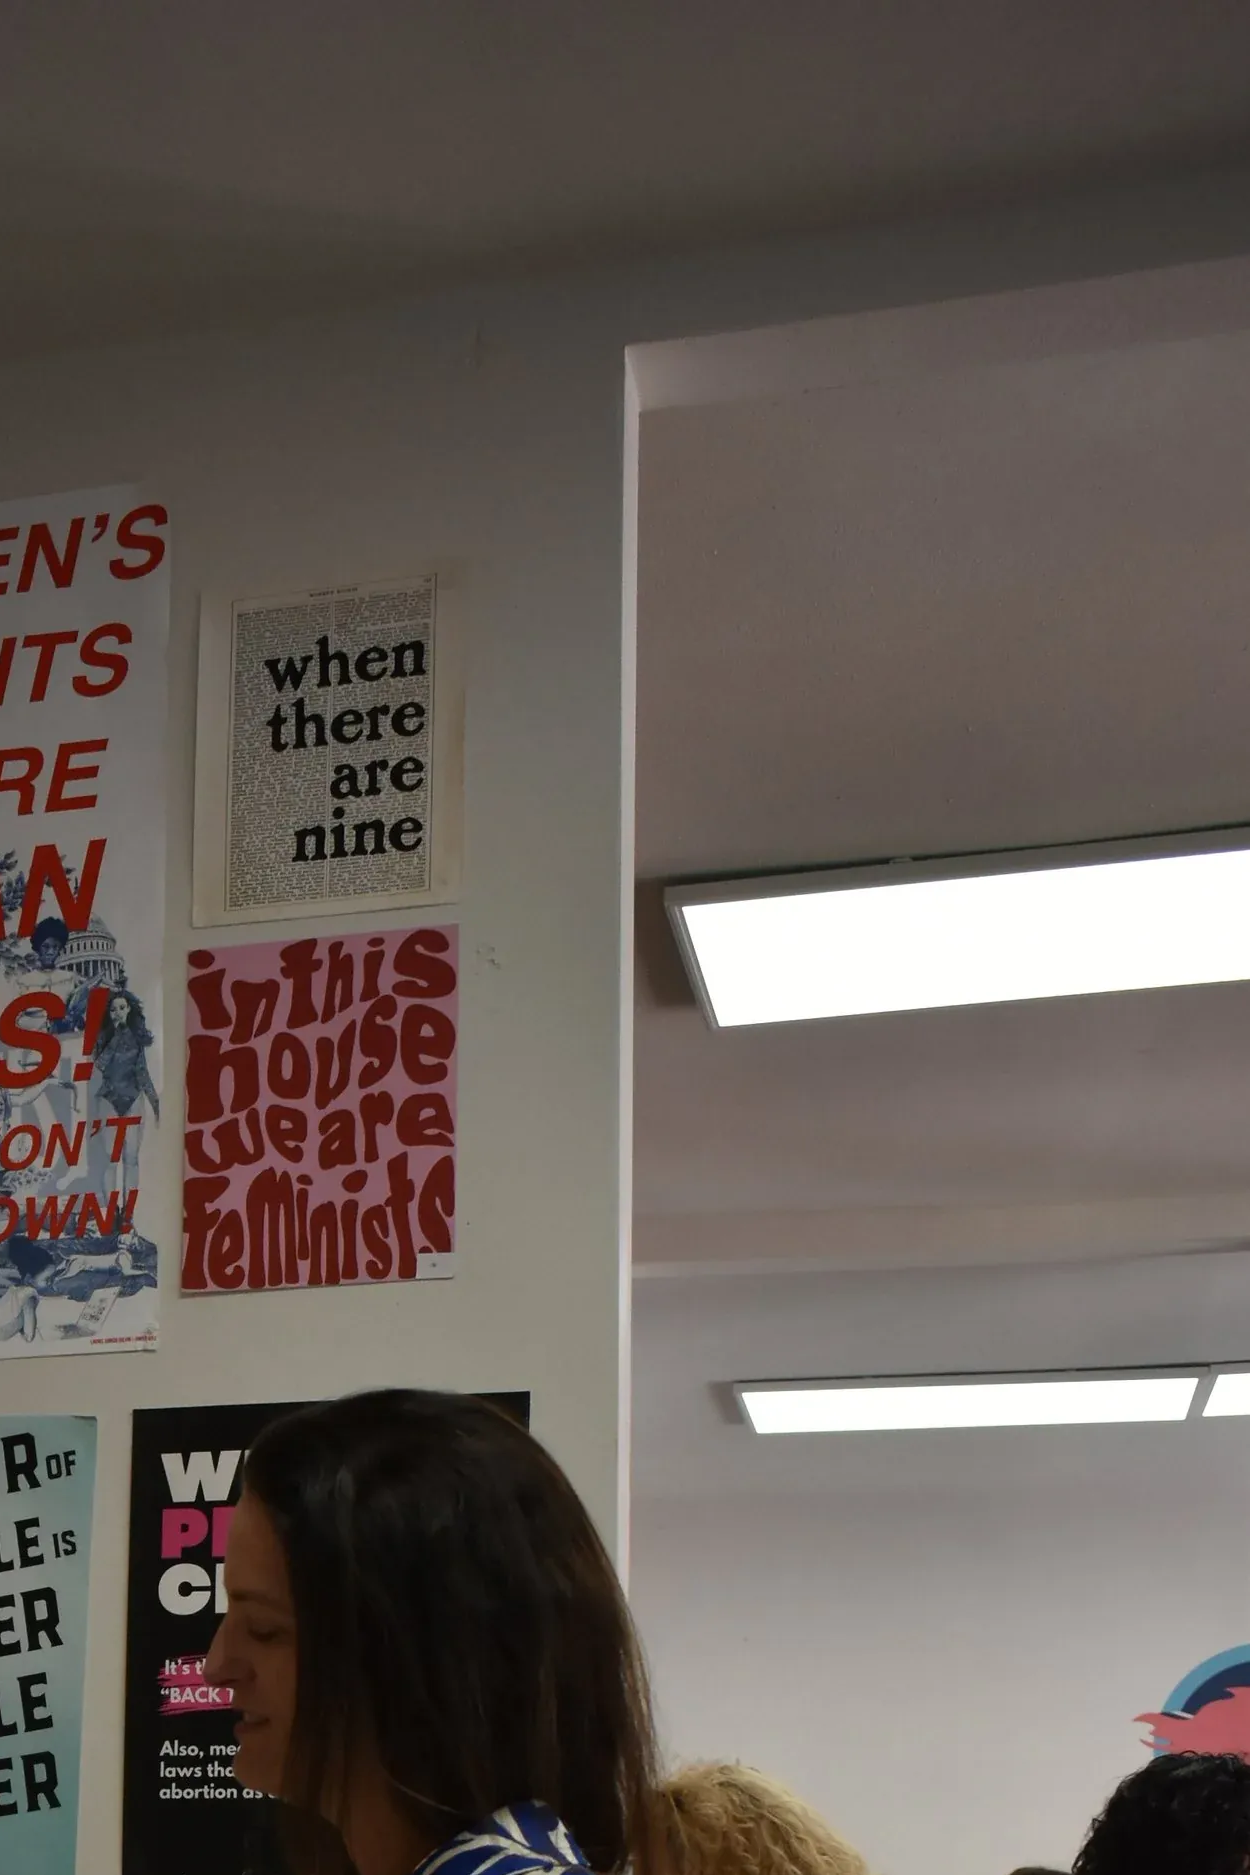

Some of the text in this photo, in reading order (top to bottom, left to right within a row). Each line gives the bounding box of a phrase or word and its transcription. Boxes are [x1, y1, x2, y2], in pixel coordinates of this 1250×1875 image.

[264, 635, 427, 692] when
[266, 698, 426, 752] there
[330, 756, 425, 800] are
[292, 806, 424, 862] nine
[187, 929, 457, 1045] in this
[186, 994, 456, 1124] house
[185, 1091, 455, 1174] we are
[45, 1450, 76, 1480] OF
[52, 1530, 77, 1559] IS
[165, 1658, 191, 1676] It's
[159, 1740, 204, 1759] Also,
[159, 1761, 202, 1778] laws
[159, 1783, 237, 1800] abortion
